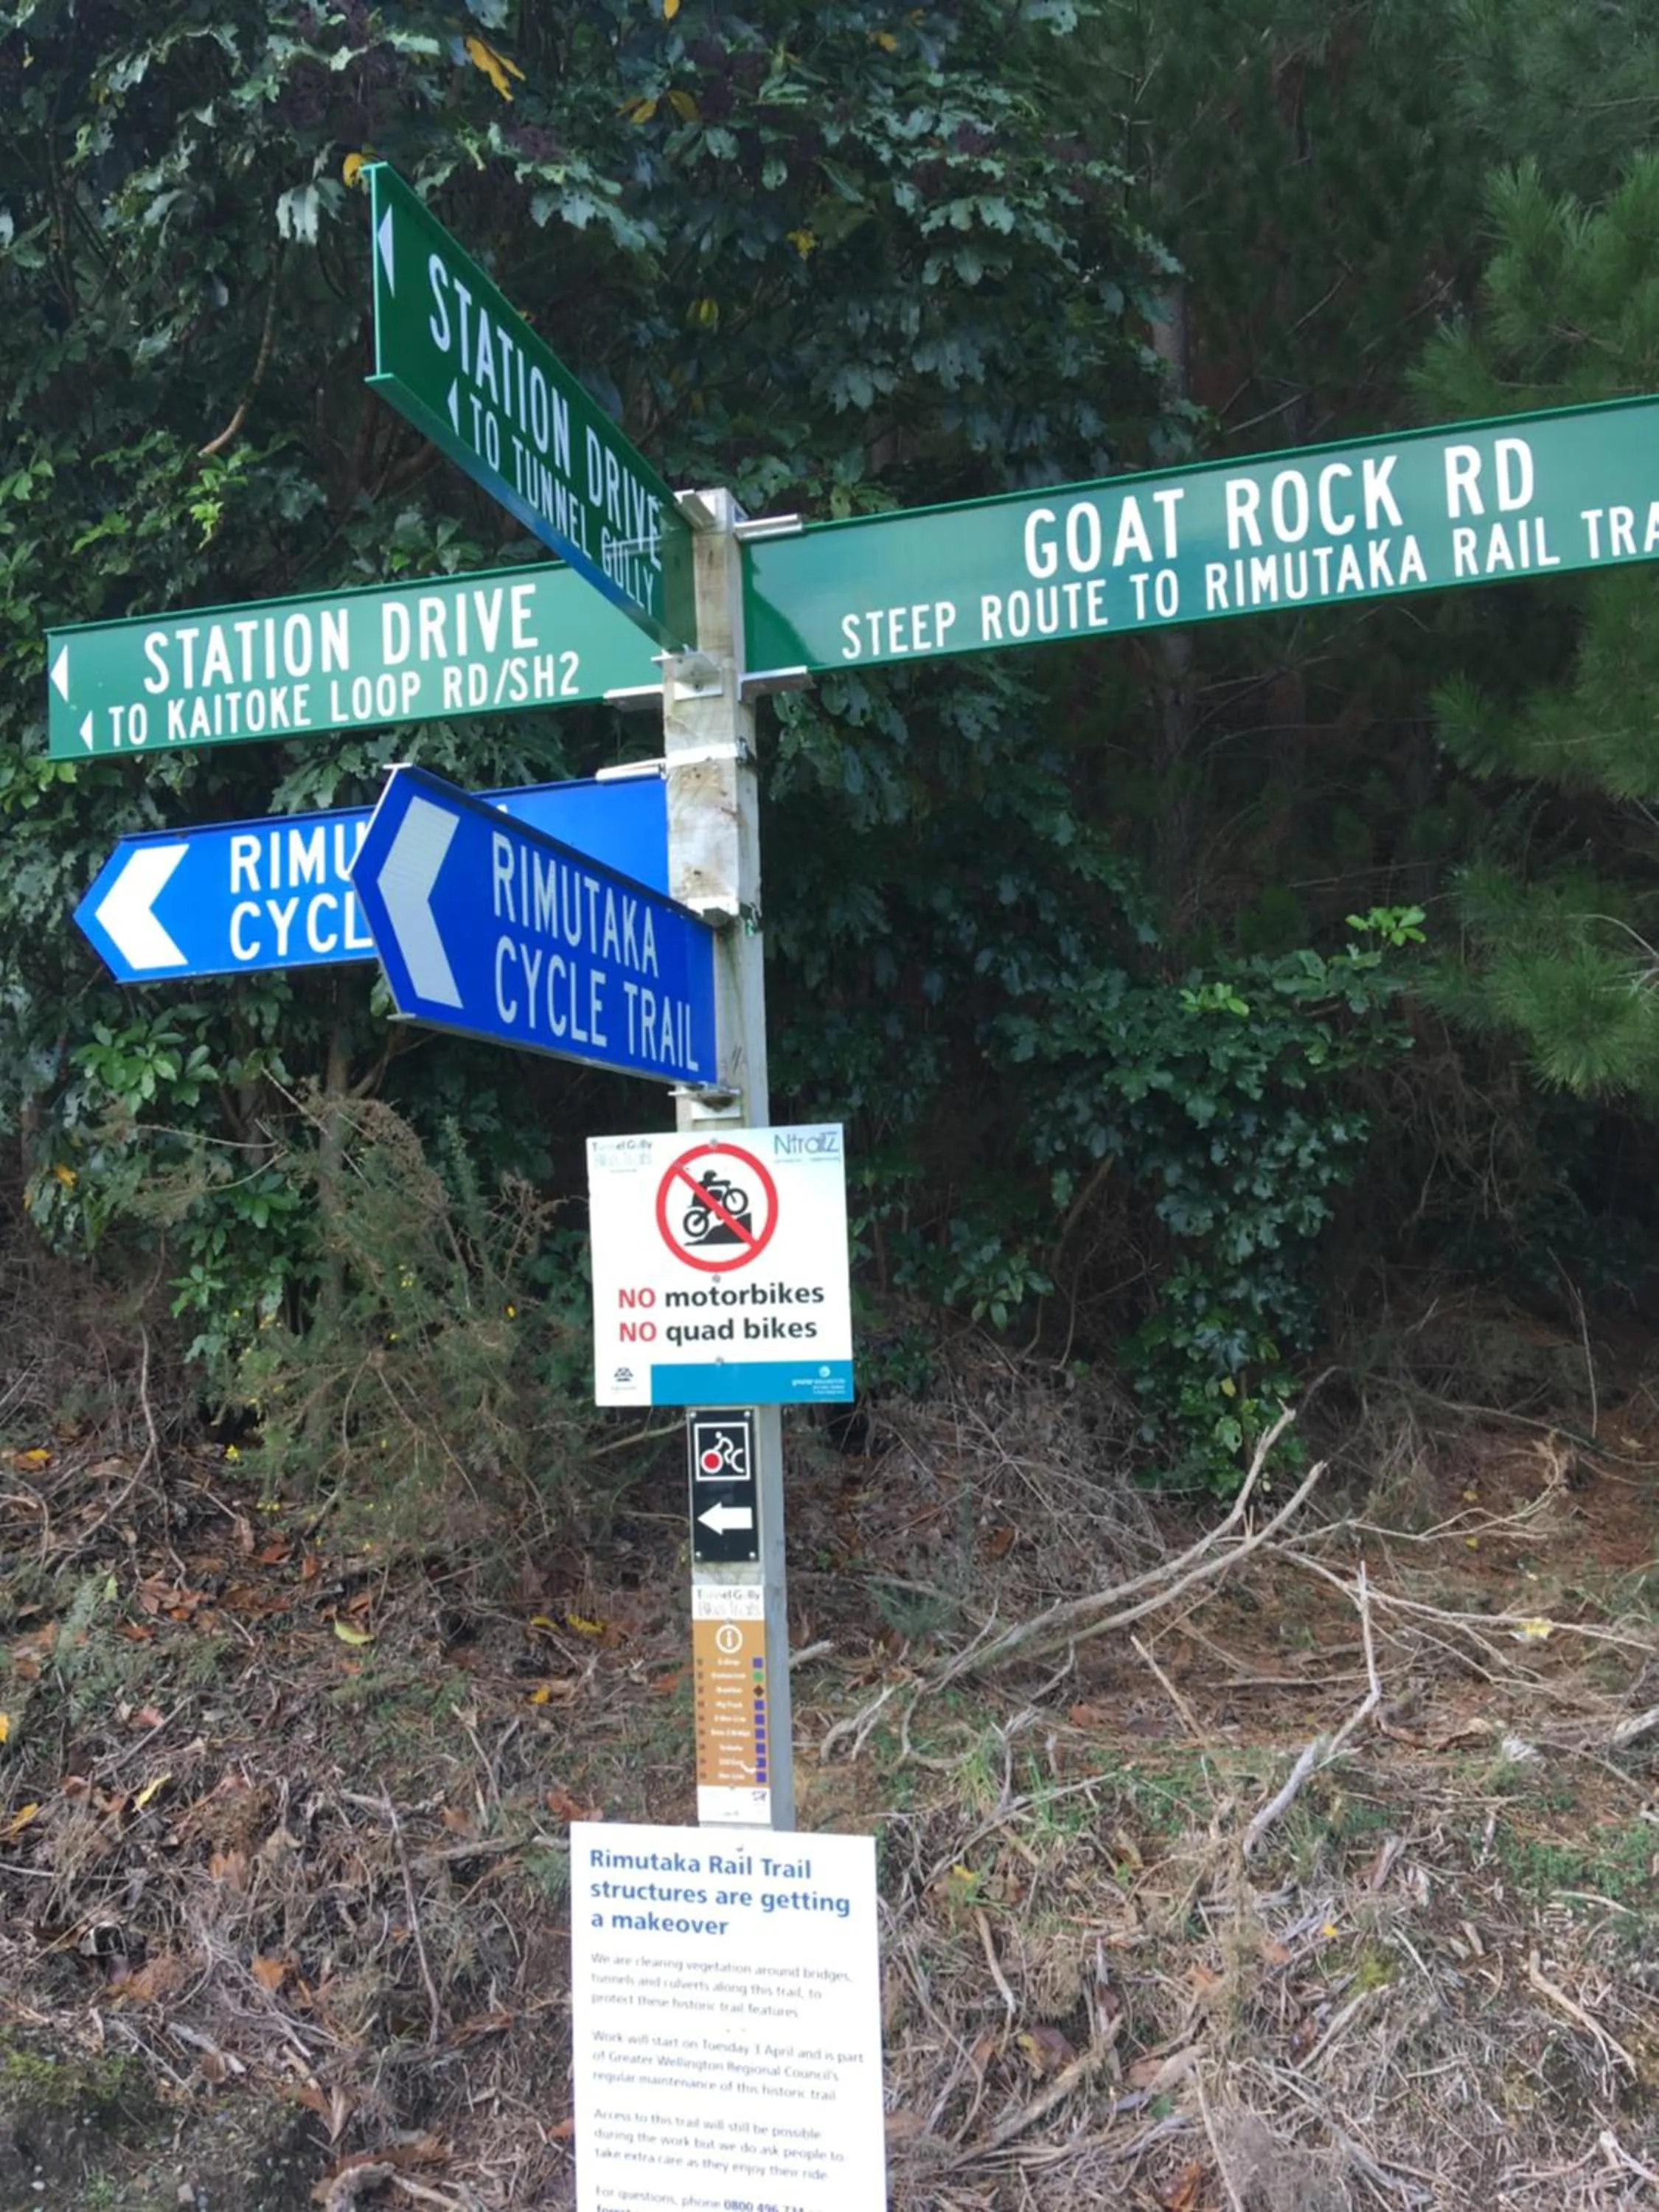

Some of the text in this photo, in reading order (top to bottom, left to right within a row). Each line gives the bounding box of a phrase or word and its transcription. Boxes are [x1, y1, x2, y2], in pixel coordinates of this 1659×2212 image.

[428, 253, 662, 572] STATION DRIVE
[470, 392, 654, 616] TO TUNNEL GULLY
[1024, 438, 1534, 579] GOAT ROCK RD
[841, 601, 956, 660] STEEP
[981, 579, 1107, 641] ROUTE
[1130, 569, 1180, 620] TO
[1205, 535, 1427, 611] RIMUTAKA
[1453, 517, 1560, 577] RAIL
[143, 583, 538, 695] STATION DRIVE
[108, 651, 581, 748] TO KAITOKE LOOP RD/SH2
[491, 831, 659, 980] RIMUTAKA
[493, 936, 700, 1072] CYCLE TRAIL
[618, 1281, 824, 1309] NO motorbikes
[619, 1317, 818, 1347] NO quad bikes
[590, 1849, 812, 1879] Rimutaka Rail Trail
[591, 1880, 851, 1918] structures are getting
[591, 1912, 729, 1935] a makeover
[591, 1952, 611, 1964] We
[613, 1956, 633, 1966] are
[635, 1955, 684, 1972] clearing
[686, 1961, 751, 1975] vegetation
[754, 1965, 800, 1978] around
[591, 1972, 635, 1986] tunnels
[638, 1976, 661, 1988] and
[663, 1977, 710, 1992] culverts
[712, 1981, 748, 1997] along
[750, 1983, 773, 1997] this
[808, 1988, 822, 2000] to
[591, 1993, 633, 2006] protect
[637, 1994, 669, 2008] these
[672, 1996, 714, 2012] historic
[720, 2001, 744, 2014] trail
[591, 2028, 622, 2042] Work
[627, 2033, 649, 2046] will
[652, 2035, 679, 2048] start
[681, 2039, 699, 2050] on
[702, 2038, 749, 2056] Tuesday
[764, 2042, 794, 2059] April
[797, 2047, 822, 2060] and
[824, 2050, 835, 2062] is
[837, 2052, 864, 2065] part
[592, 2050, 605, 2062] of
[608, 2050, 653, 2065] Greater
[655, 2053, 724, 2073] Wellington
[726, 2060, 781, 2077] Regional
[593, 2070, 635, 2085] regular
[639, 2075, 717, 2090] maintenance
[720, 2079, 733, 2092] of
[737, 2081, 759, 2095] this
[762, 2083, 806, 2100] historic
[594, 2107, 822, 2141] Access to this trail will still be possible
[594, 2128, 844, 2163] during the work but we do ask people to
[595, 2146, 622, 2159] take
[624, 2151, 655, 2164] extra
[657, 2154, 684, 2166] care
[686, 2158, 700, 2168] as
[701, 2158, 729, 2174] they
[731, 2163, 765, 2177] enjoy
[769, 2164, 798, 2177] their
[681, 2194, 720, 2208] phone
[723, 2198, 754, 2212] 0800
